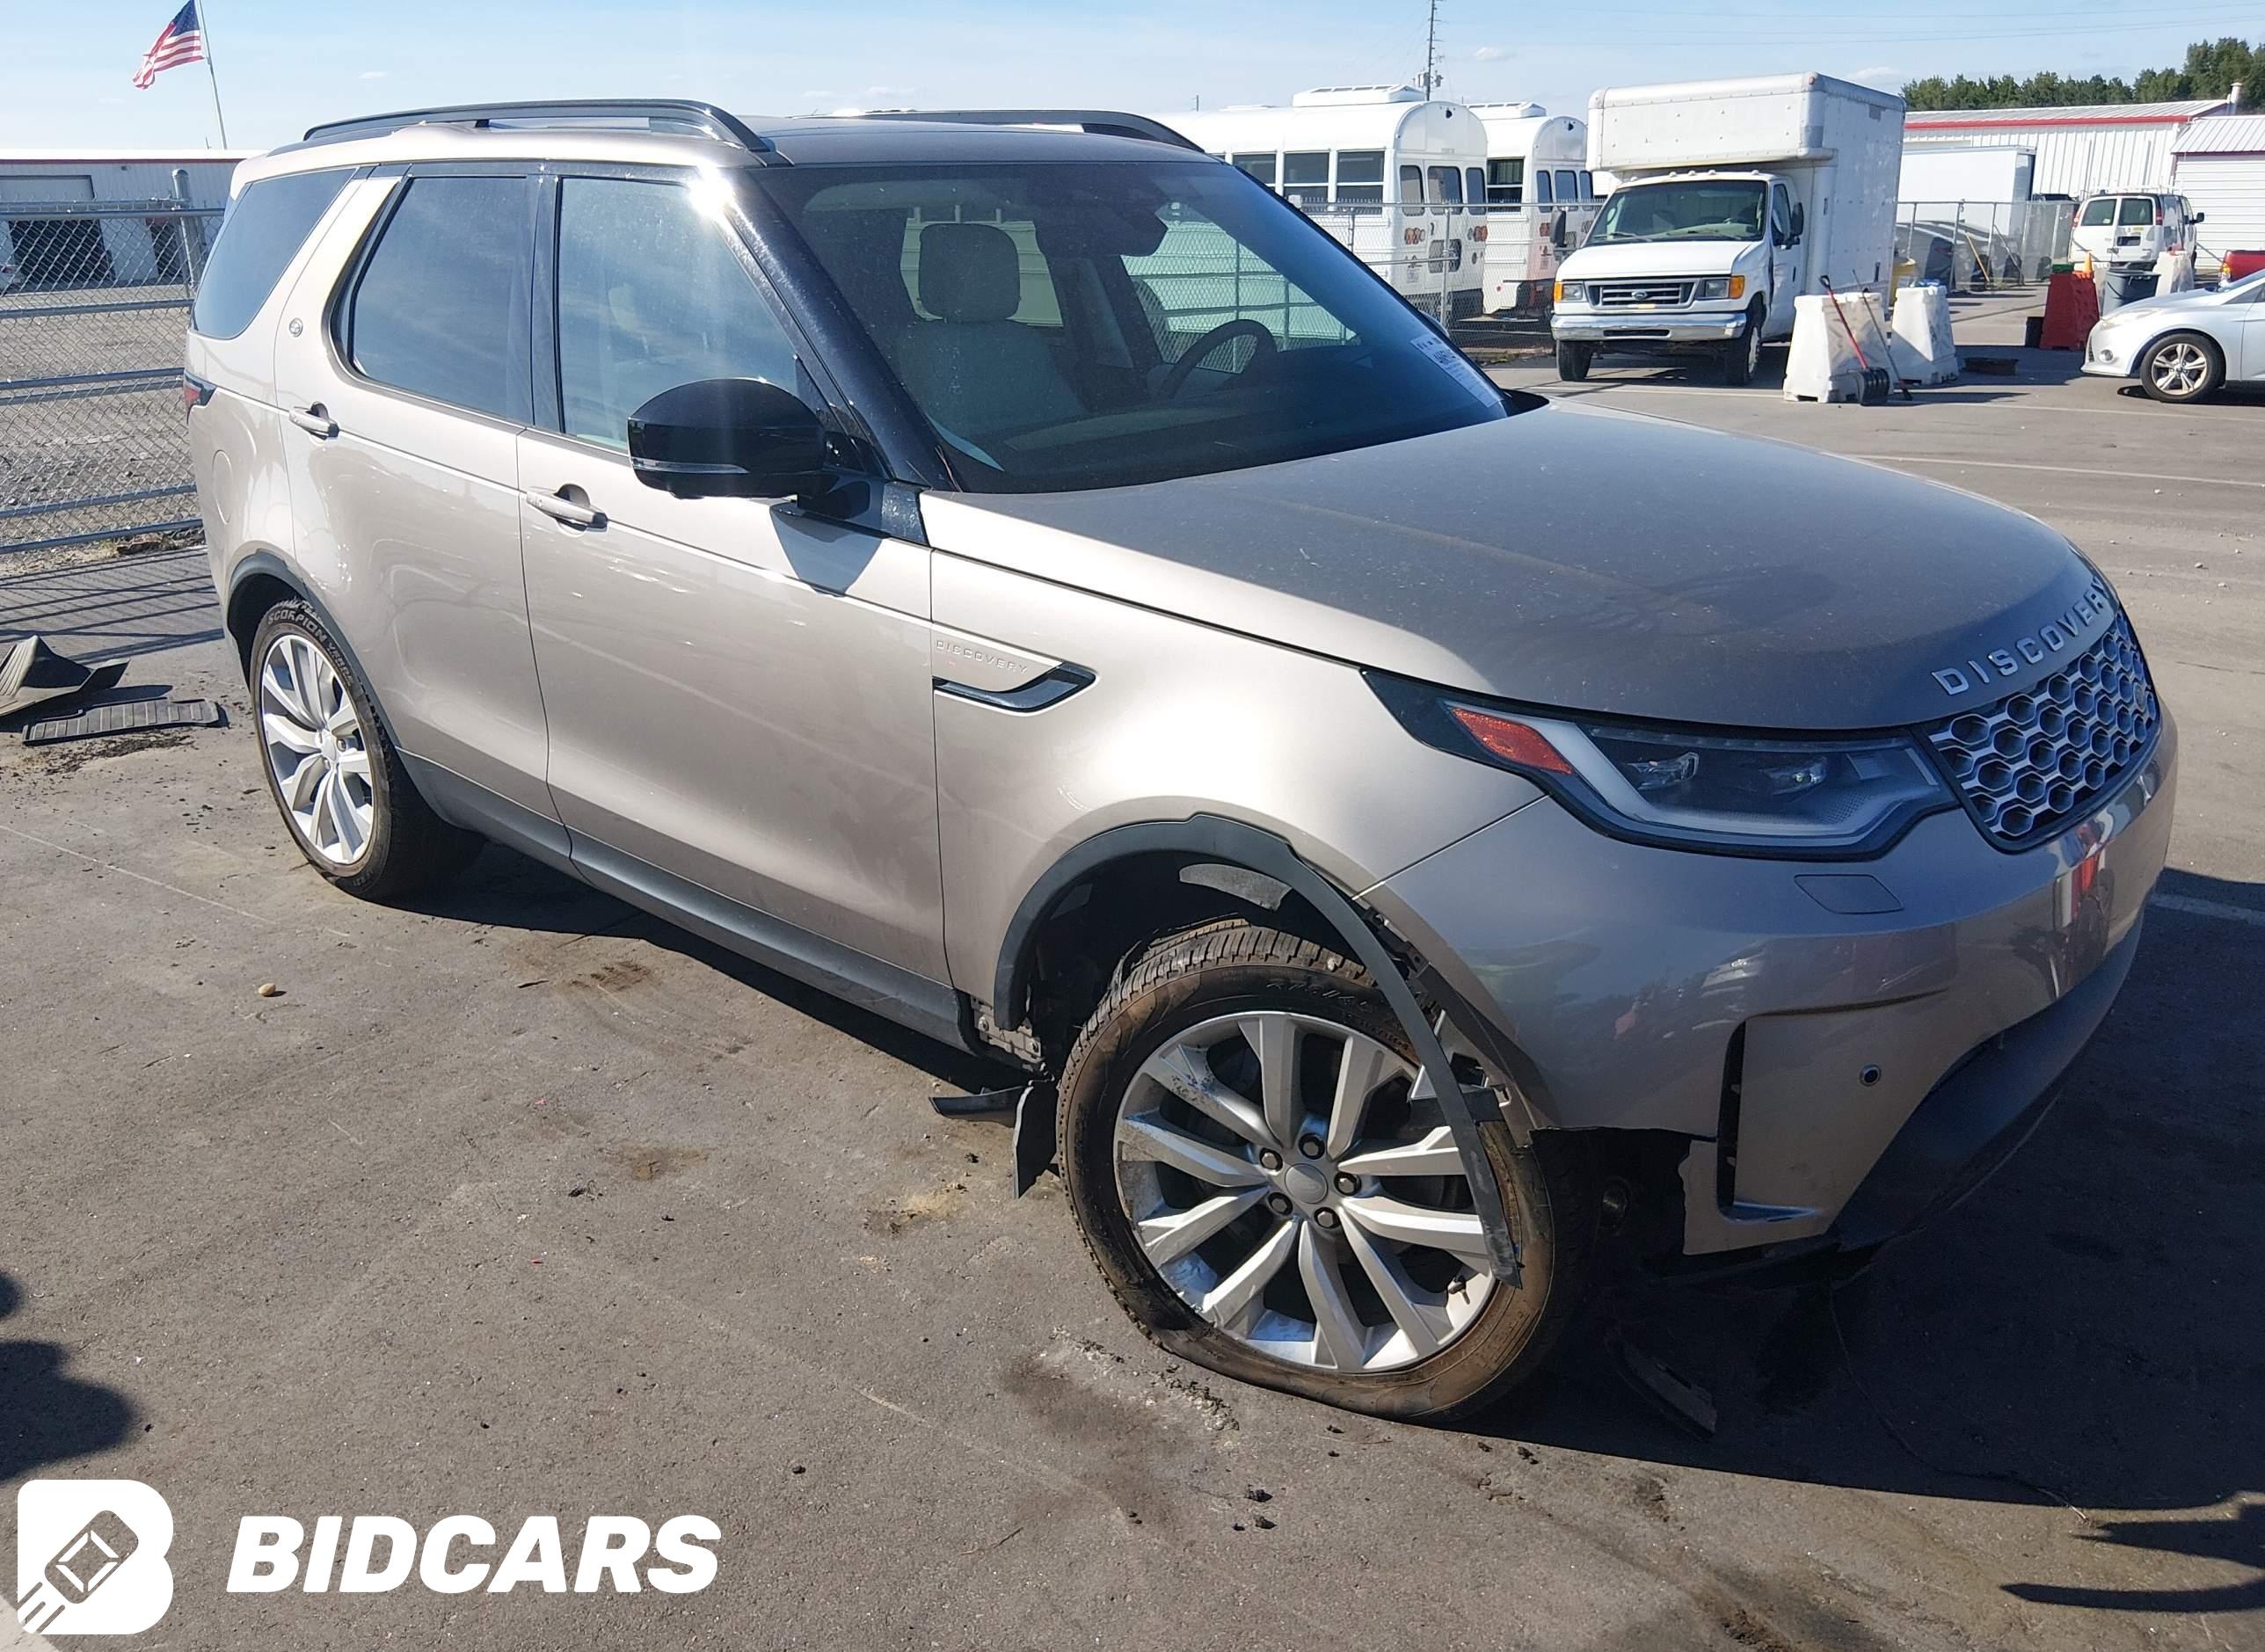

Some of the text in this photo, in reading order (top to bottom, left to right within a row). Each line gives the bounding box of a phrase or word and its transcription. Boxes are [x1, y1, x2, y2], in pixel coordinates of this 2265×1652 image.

[267, 609, 327, 642] SCORPION
[1931, 577, 2109, 695] DISCOVERY
[935, 639, 1028, 675] DISCOVERY
